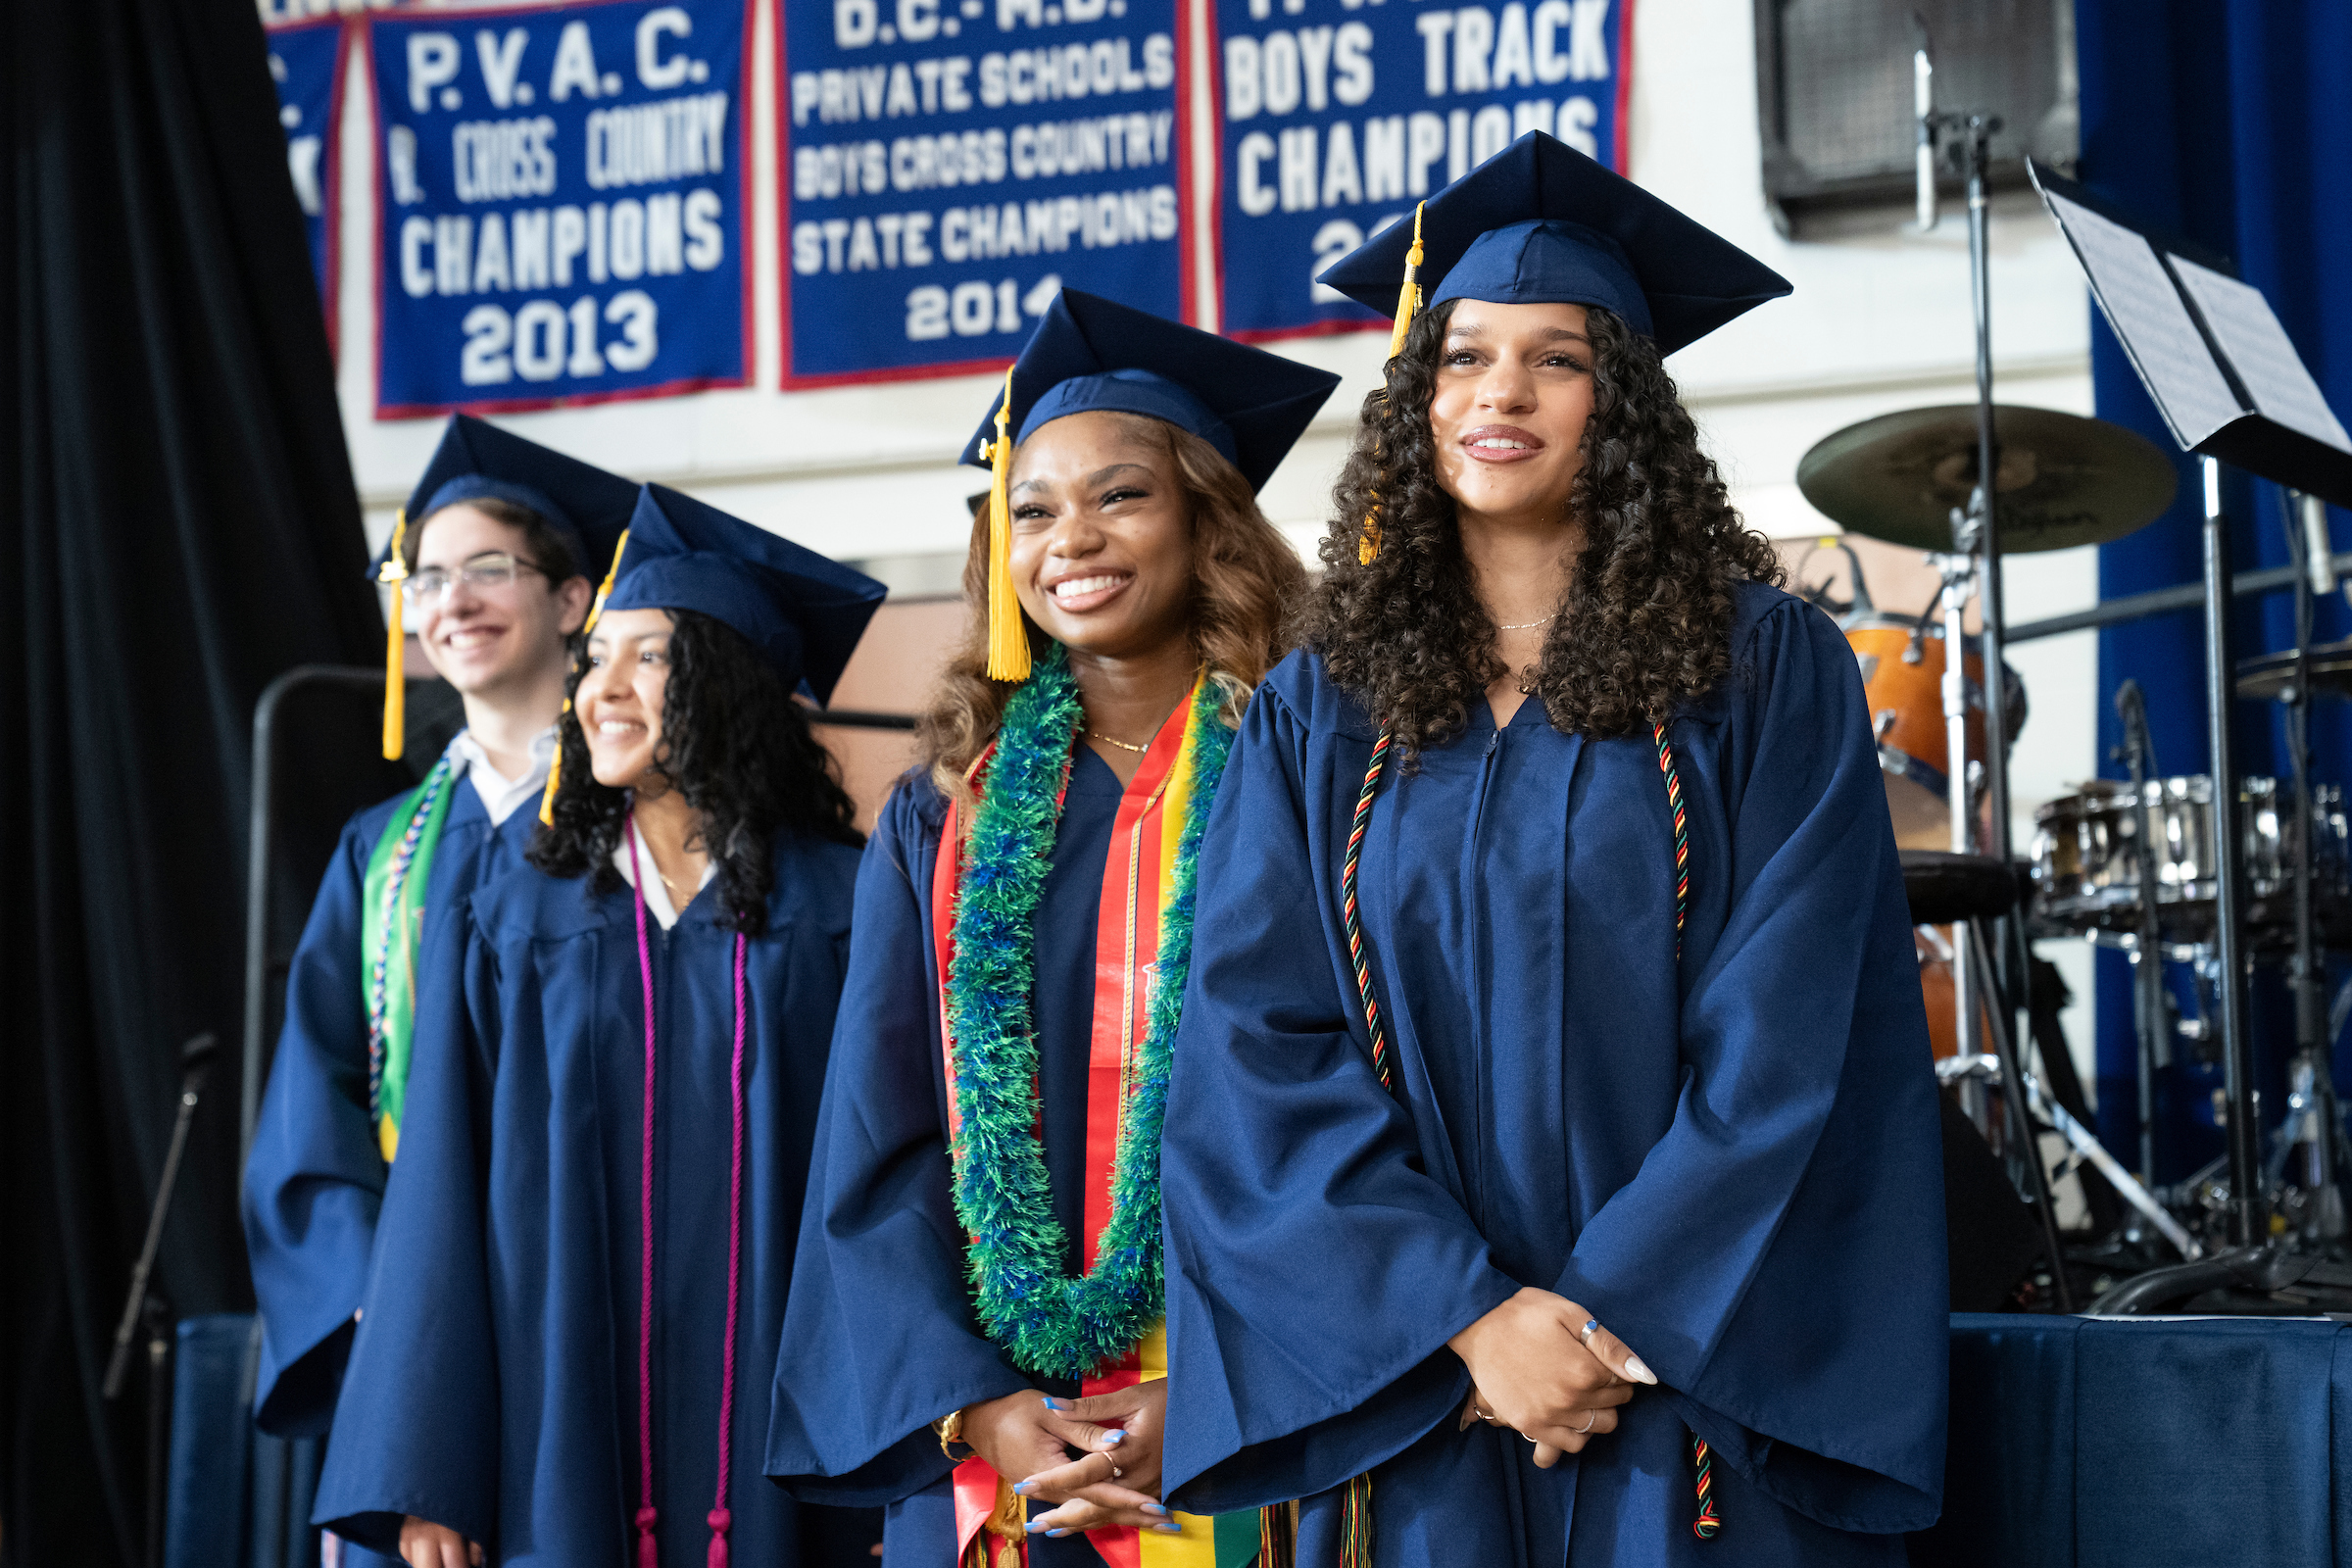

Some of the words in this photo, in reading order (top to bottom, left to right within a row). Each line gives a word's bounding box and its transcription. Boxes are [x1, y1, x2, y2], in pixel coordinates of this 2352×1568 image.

[791, 57, 972, 125] PRIVATE
[979, 33, 1174, 107] SCHOOLS
[1224, 22, 1374, 121] BOYS
[1416, 1, 1609, 97] TRACK
[453, 117, 556, 202] CROSS
[586, 91, 727, 188] COUNTRY
[794, 140, 887, 200] BOYS
[891, 128, 1007, 191] CROSS
[1011, 111, 1173, 179] COUNTRY
[401, 189, 723, 297] CHAMPIONS
[792, 212, 933, 274] STATE
[941, 185, 1178, 262] CHAMPIONS
[462, 290, 658, 385] 2013
